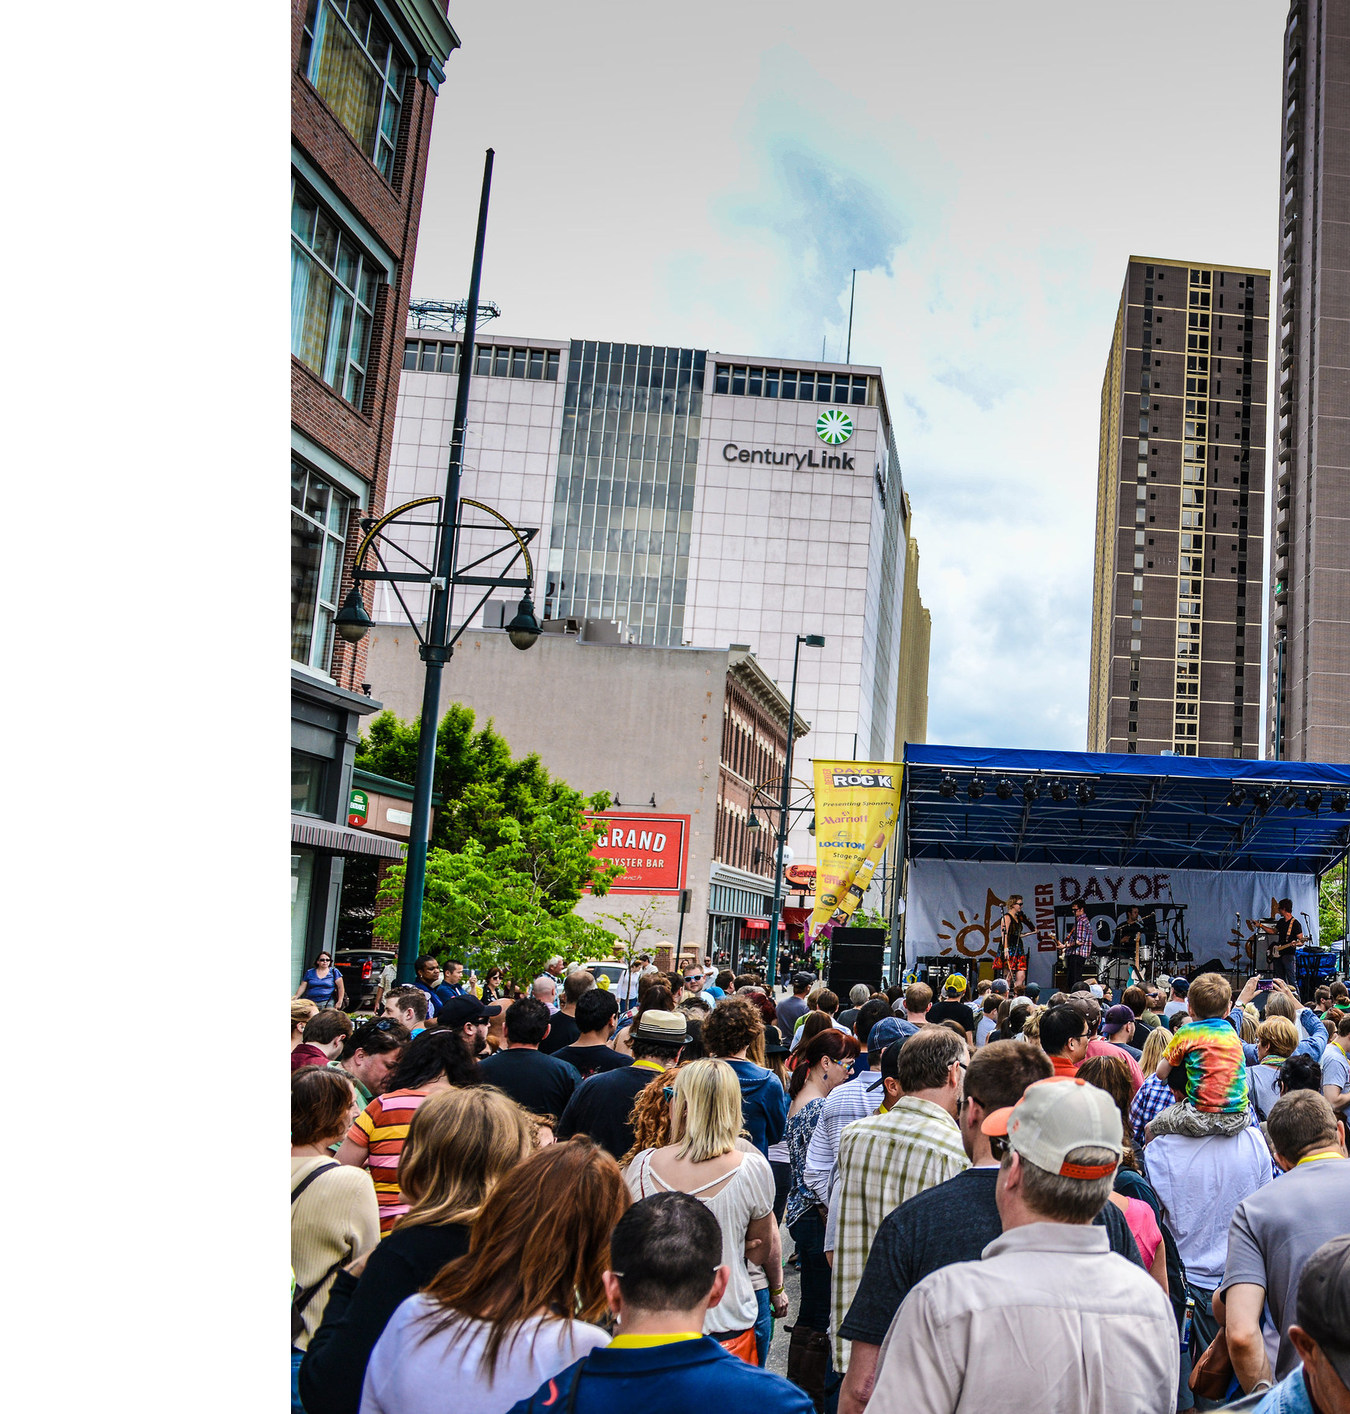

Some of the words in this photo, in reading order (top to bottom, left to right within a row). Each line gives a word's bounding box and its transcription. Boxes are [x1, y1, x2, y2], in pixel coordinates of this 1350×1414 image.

[723, 443, 855, 471] CenturyLink
[832, 775, 892, 788] ROCK
[820, 815, 868, 825] Marriott
[597, 828, 667, 852] GRAND
[819, 841, 866, 850] LOCKTON
[833, 852, 852, 860] Stage
[646, 859, 664, 868] BAR
[824, 878, 847, 888] CITIES
[1059, 876, 1125, 902] DAY
[1128, 873, 1171, 900] OF
[822, 896, 837, 904] PCL
[1034, 883, 1057, 952] DENVER
